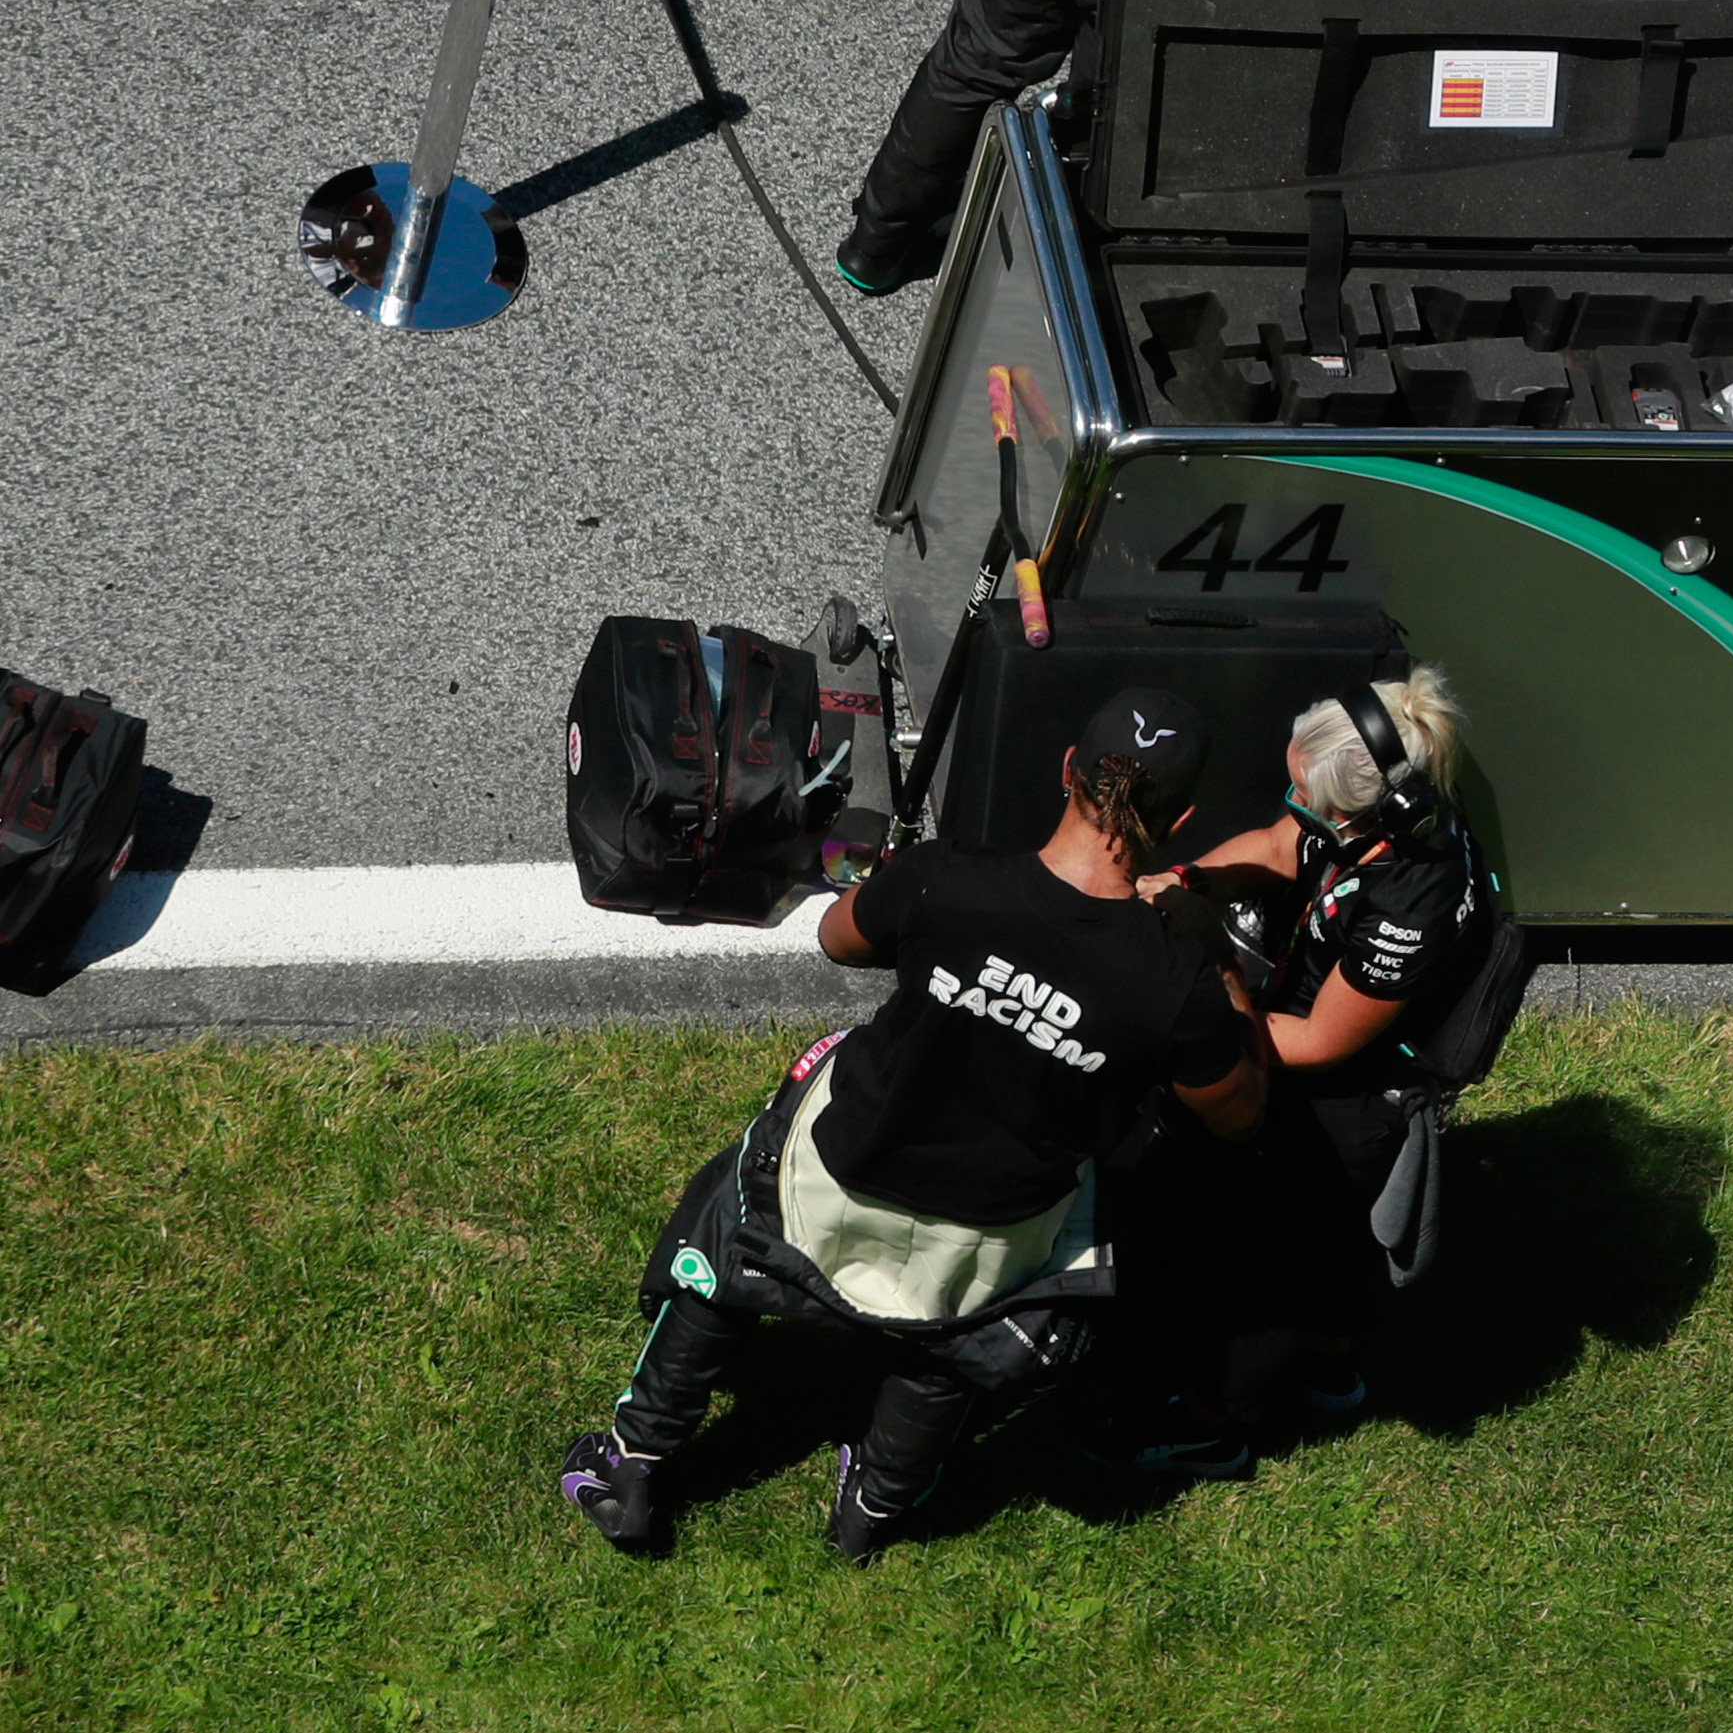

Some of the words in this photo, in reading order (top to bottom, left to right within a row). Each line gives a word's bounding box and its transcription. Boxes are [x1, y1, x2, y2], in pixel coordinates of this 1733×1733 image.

[1156, 503, 1350, 593] 44
[1378, 920, 1423, 942] EPSON
[1370, 938, 1421, 955] BOSE
[1361, 961, 1402, 981] TIBCO
[1373, 953, 1404, 969] IWC
[977, 954, 1082, 1030] END
[928, 965, 1107, 1073] RACISM
